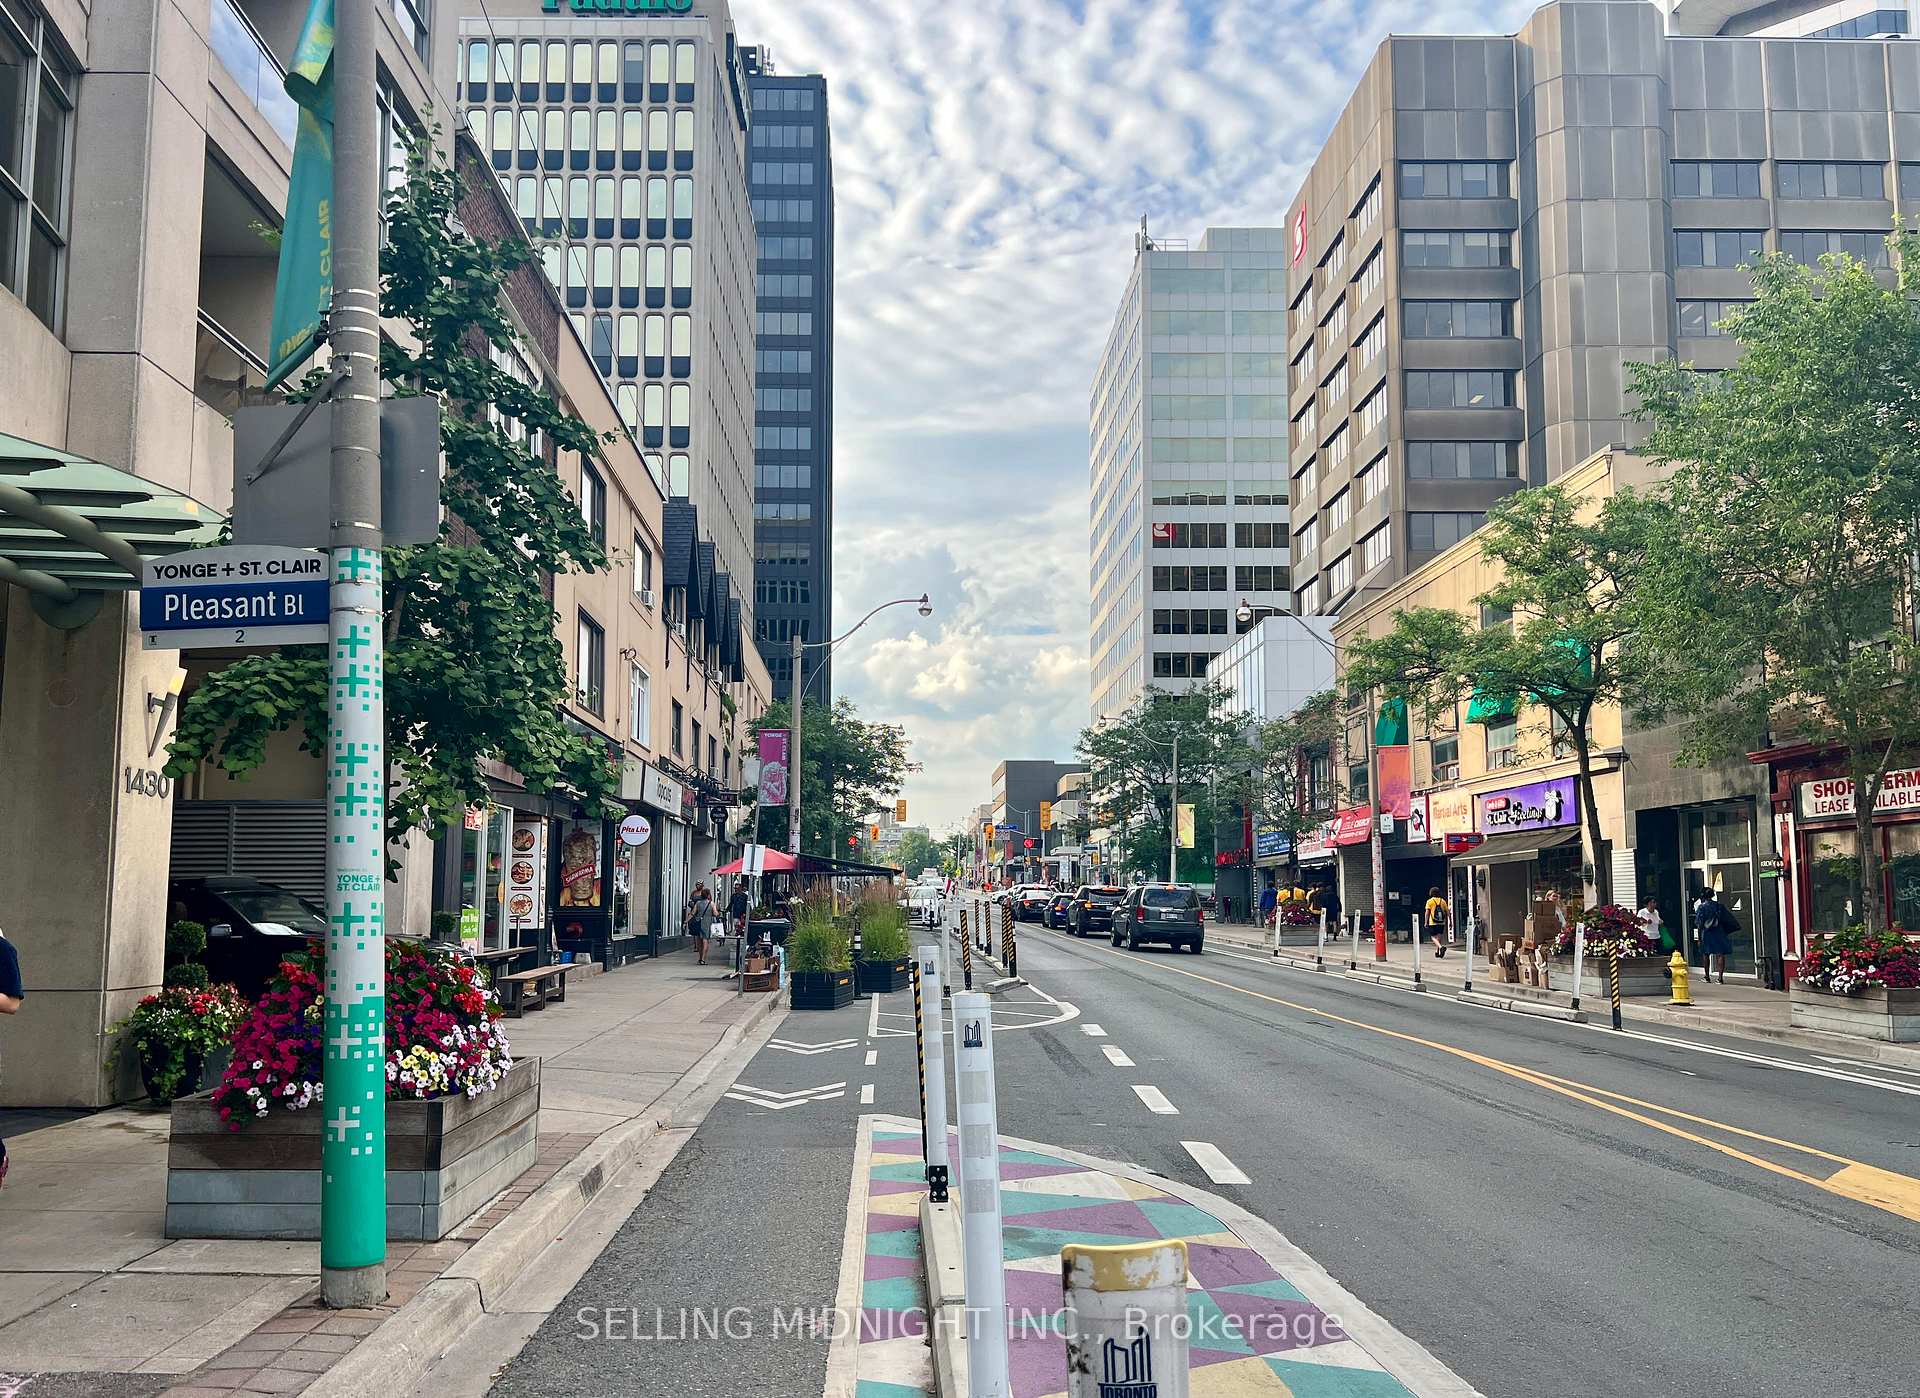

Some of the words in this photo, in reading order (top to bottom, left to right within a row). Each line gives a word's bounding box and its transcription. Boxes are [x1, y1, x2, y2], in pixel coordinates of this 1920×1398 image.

[153, 563, 217, 579] YONGE
[222, 563, 235, 576] +
[239, 561, 262, 576] ST.
[266, 559, 321, 574] CLAIR
[165, 591, 276, 621] Pleasant
[284, 594, 304, 616] Bl
[235, 630, 245, 643] 2
[125, 766, 170, 799] 1430
[1880, 768, 1920, 791] ERM
[1815, 799, 1849, 813] LEASE
[621, 826, 635, 834] Pita
[337, 875, 373, 883] YONGE
[336, 883, 349, 891] ST.
[352, 883, 380, 891] CLAIR
